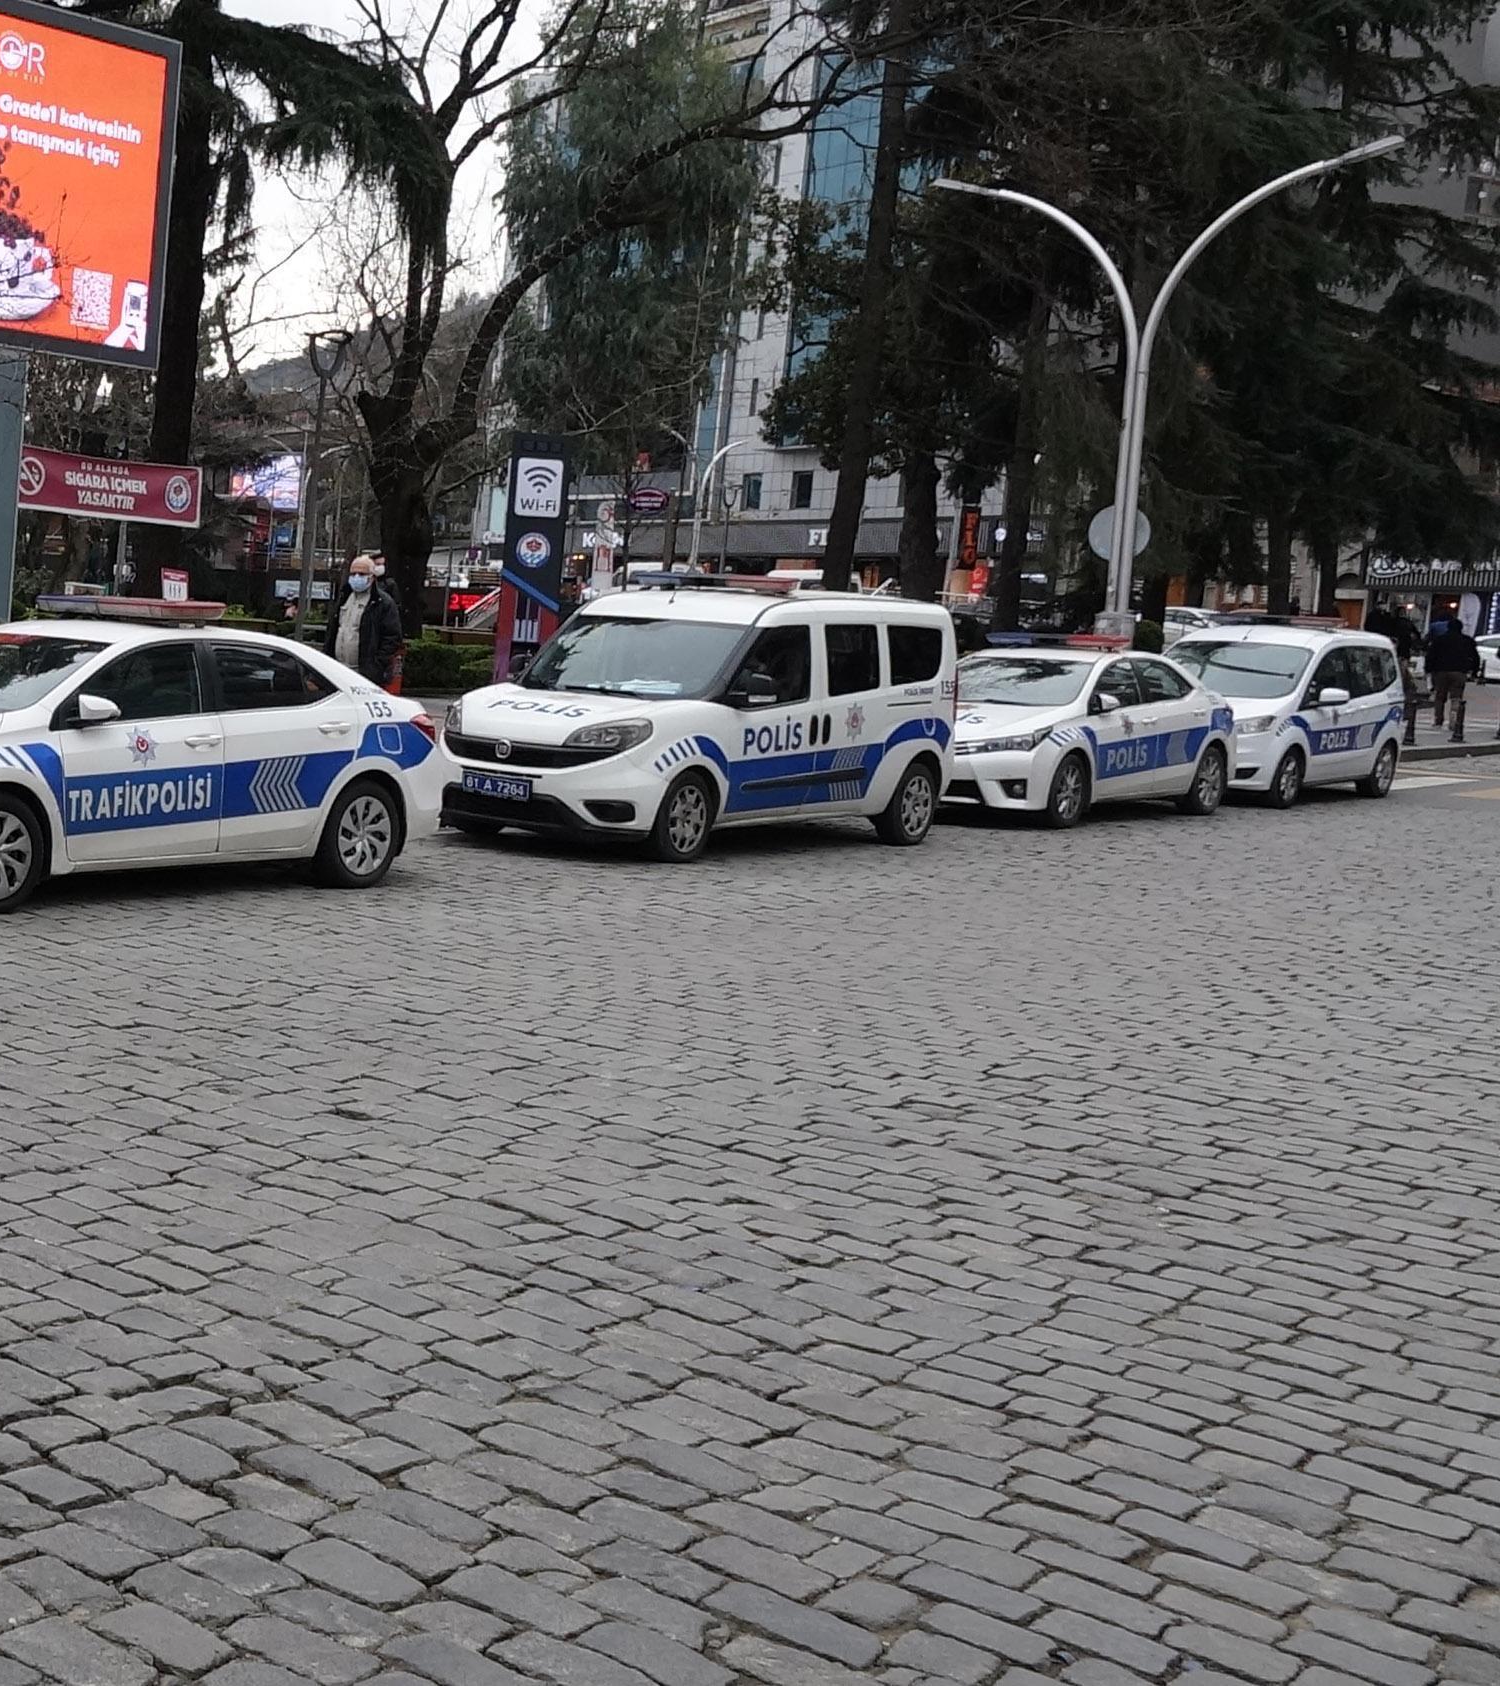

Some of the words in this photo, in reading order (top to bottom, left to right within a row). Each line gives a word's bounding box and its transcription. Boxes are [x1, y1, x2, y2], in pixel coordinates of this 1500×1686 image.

[59, 107, 141, 144] kahvesinin
[364, 701, 393, 718] 155
[743, 715, 802, 755] POLİS
[1318, 729, 1349, 750] POLİS
[1105, 738, 1148, 771] POLİS
